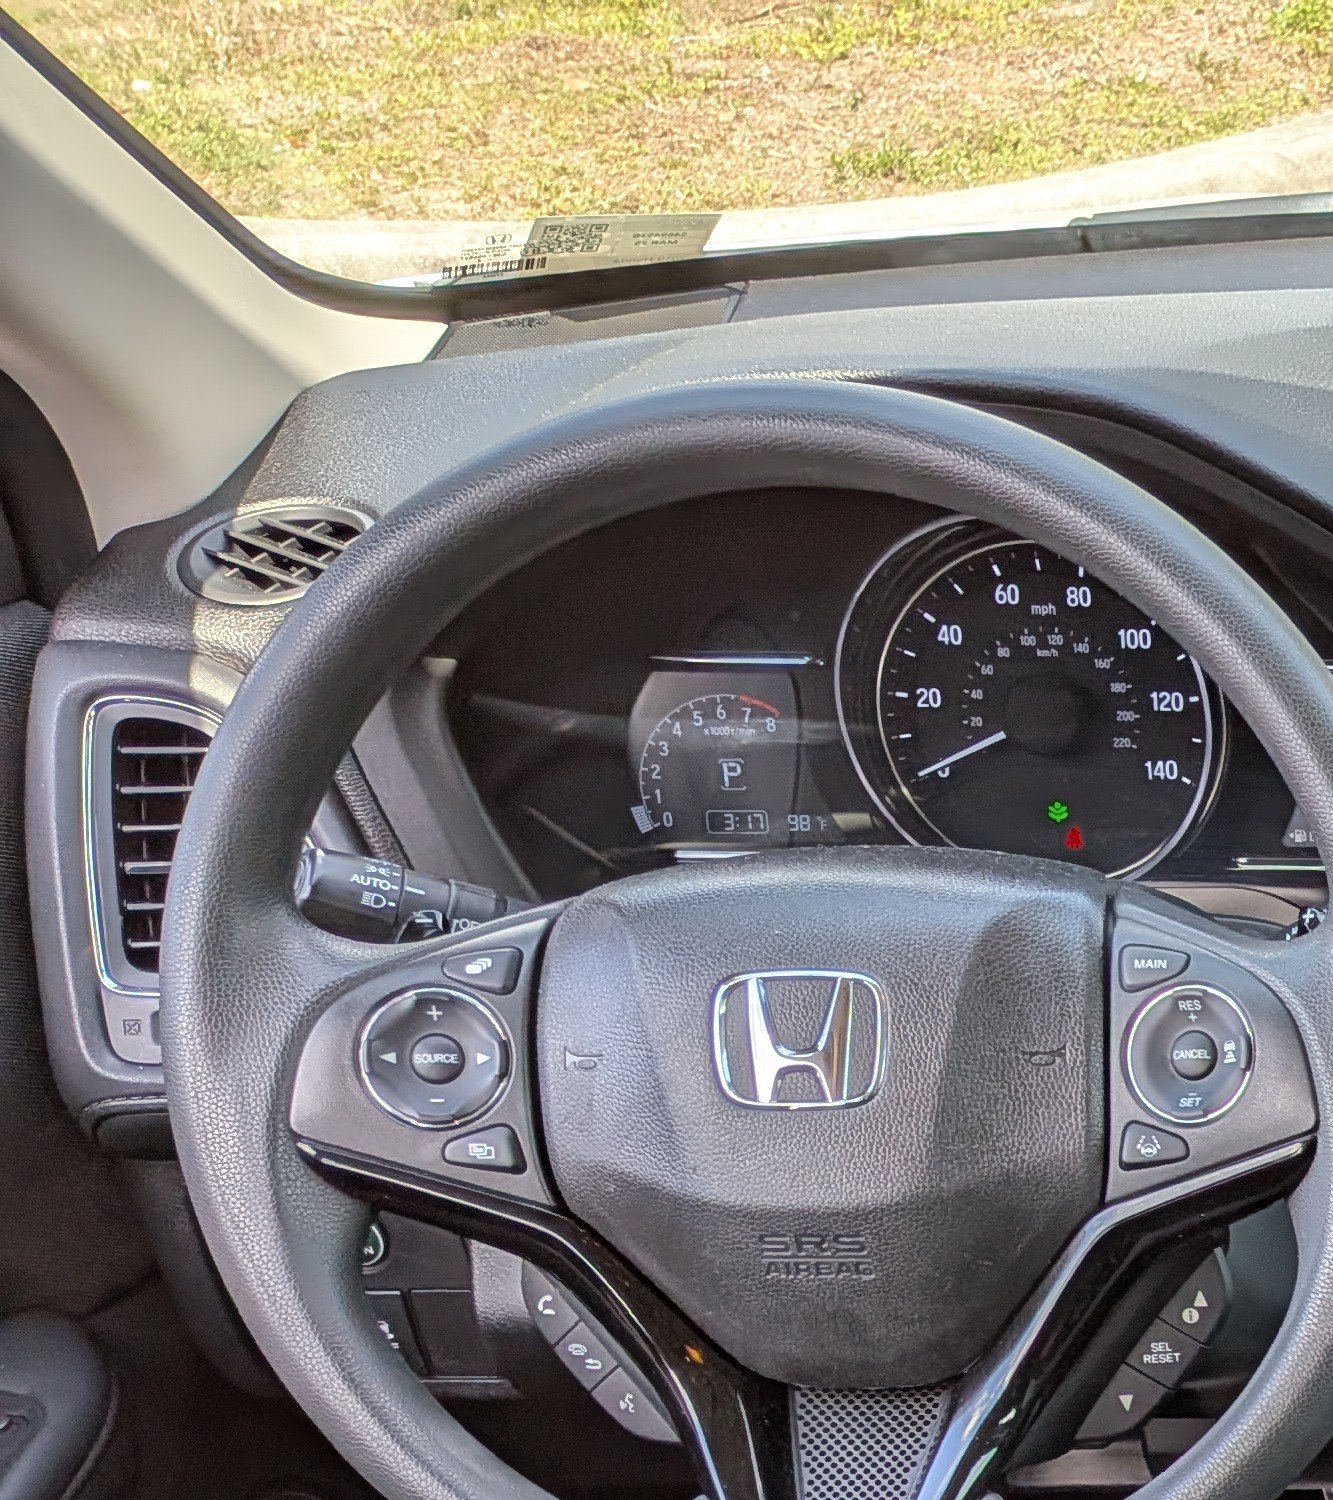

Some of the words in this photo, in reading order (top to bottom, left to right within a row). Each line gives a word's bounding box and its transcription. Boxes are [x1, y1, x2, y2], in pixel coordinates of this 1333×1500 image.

[995, 584, 1020, 605] 60
[1066, 586, 1091, 608] 80
[1031, 603, 1056, 616] mph
[937, 625, 962, 645] 40
[1019, 635, 1036, 646] 100
[1047, 635, 1063, 645] 120
[1118, 629, 1151, 650] 100
[1073, 643, 1089, 654] 140
[981, 664, 993, 675] 60
[1094, 659, 1111, 669] 160
[970, 689, 983, 700] 40
[1110, 682, 1126, 693] 180
[916, 688, 941, 708] 20
[1151, 692, 1184, 712] 120
[693, 710, 703, 727] 5
[716, 704, 726, 720] 6
[741, 707, 751, 724] 7
[1116, 711, 1135, 722] 200
[672, 721, 682, 737] 4
[765, 717, 777, 733] 8
[970, 717, 983, 727] 20
[659, 741, 669, 756] 3
[1112, 738, 1131, 748] 220
[651, 764, 662, 780] 2
[723, 763, 742, 787] P
[1145, 760, 1178, 780] 140
[654, 788, 662, 804] 1
[663, 811, 673, 828] 0
[724, 813, 764, 831] 3:17
[787, 814, 811, 832] 98
[350, 873, 392, 891] AUTO
[1134, 958, 1167, 970] MAIN
[1178, 1000, 1202, 1012] RES
[414, 1051, 459, 1066] SOURCE
[1173, 1049, 1211, 1061] CANCEL
[1179, 1096, 1202, 1108] SET
[758, 1232, 868, 1255] SRS
[763, 1260, 875, 1280] AIRBAG
[1151, 1341, 1173, 1354] SEL
[1143, 1352, 1181, 1365] RESET
